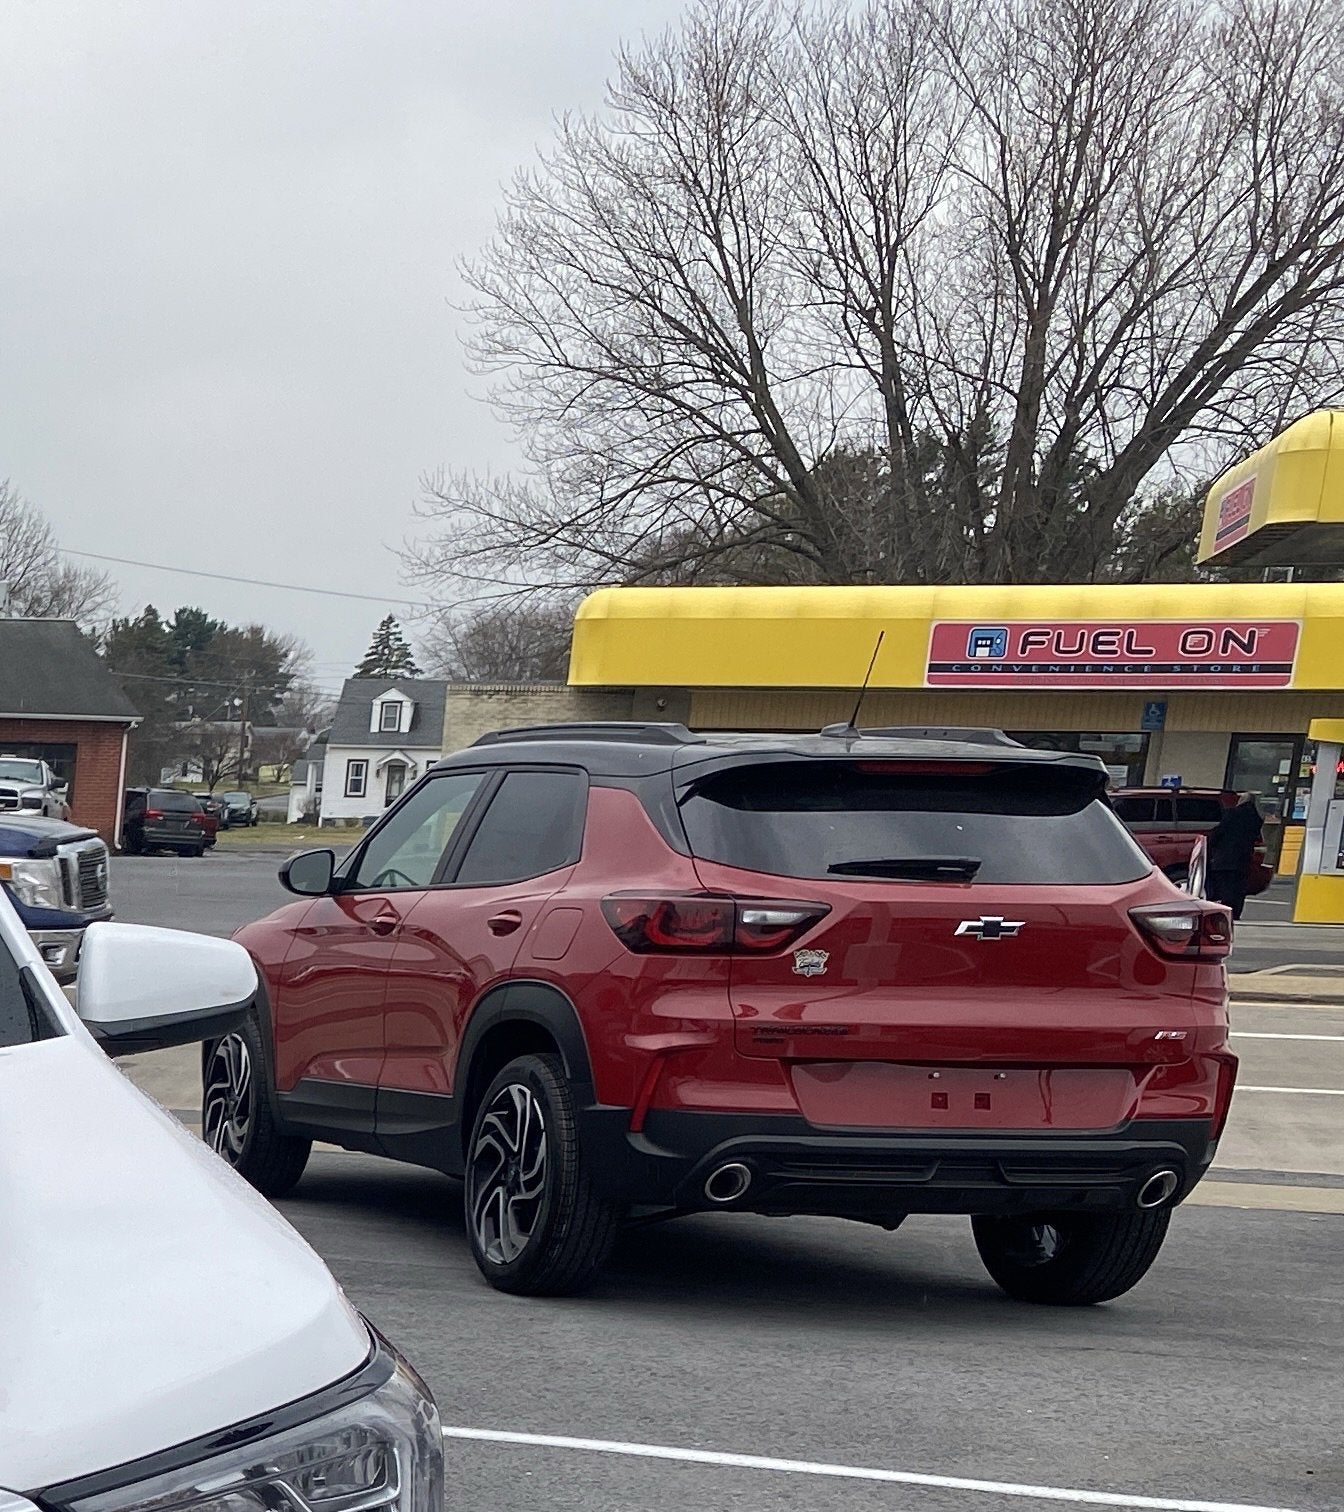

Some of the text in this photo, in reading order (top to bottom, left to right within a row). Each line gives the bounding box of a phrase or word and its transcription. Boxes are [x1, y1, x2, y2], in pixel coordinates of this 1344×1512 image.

[1018, 628, 1260, 657] FUEL ON
[951, 664, 1262, 673] CONVENIENCE STORE
